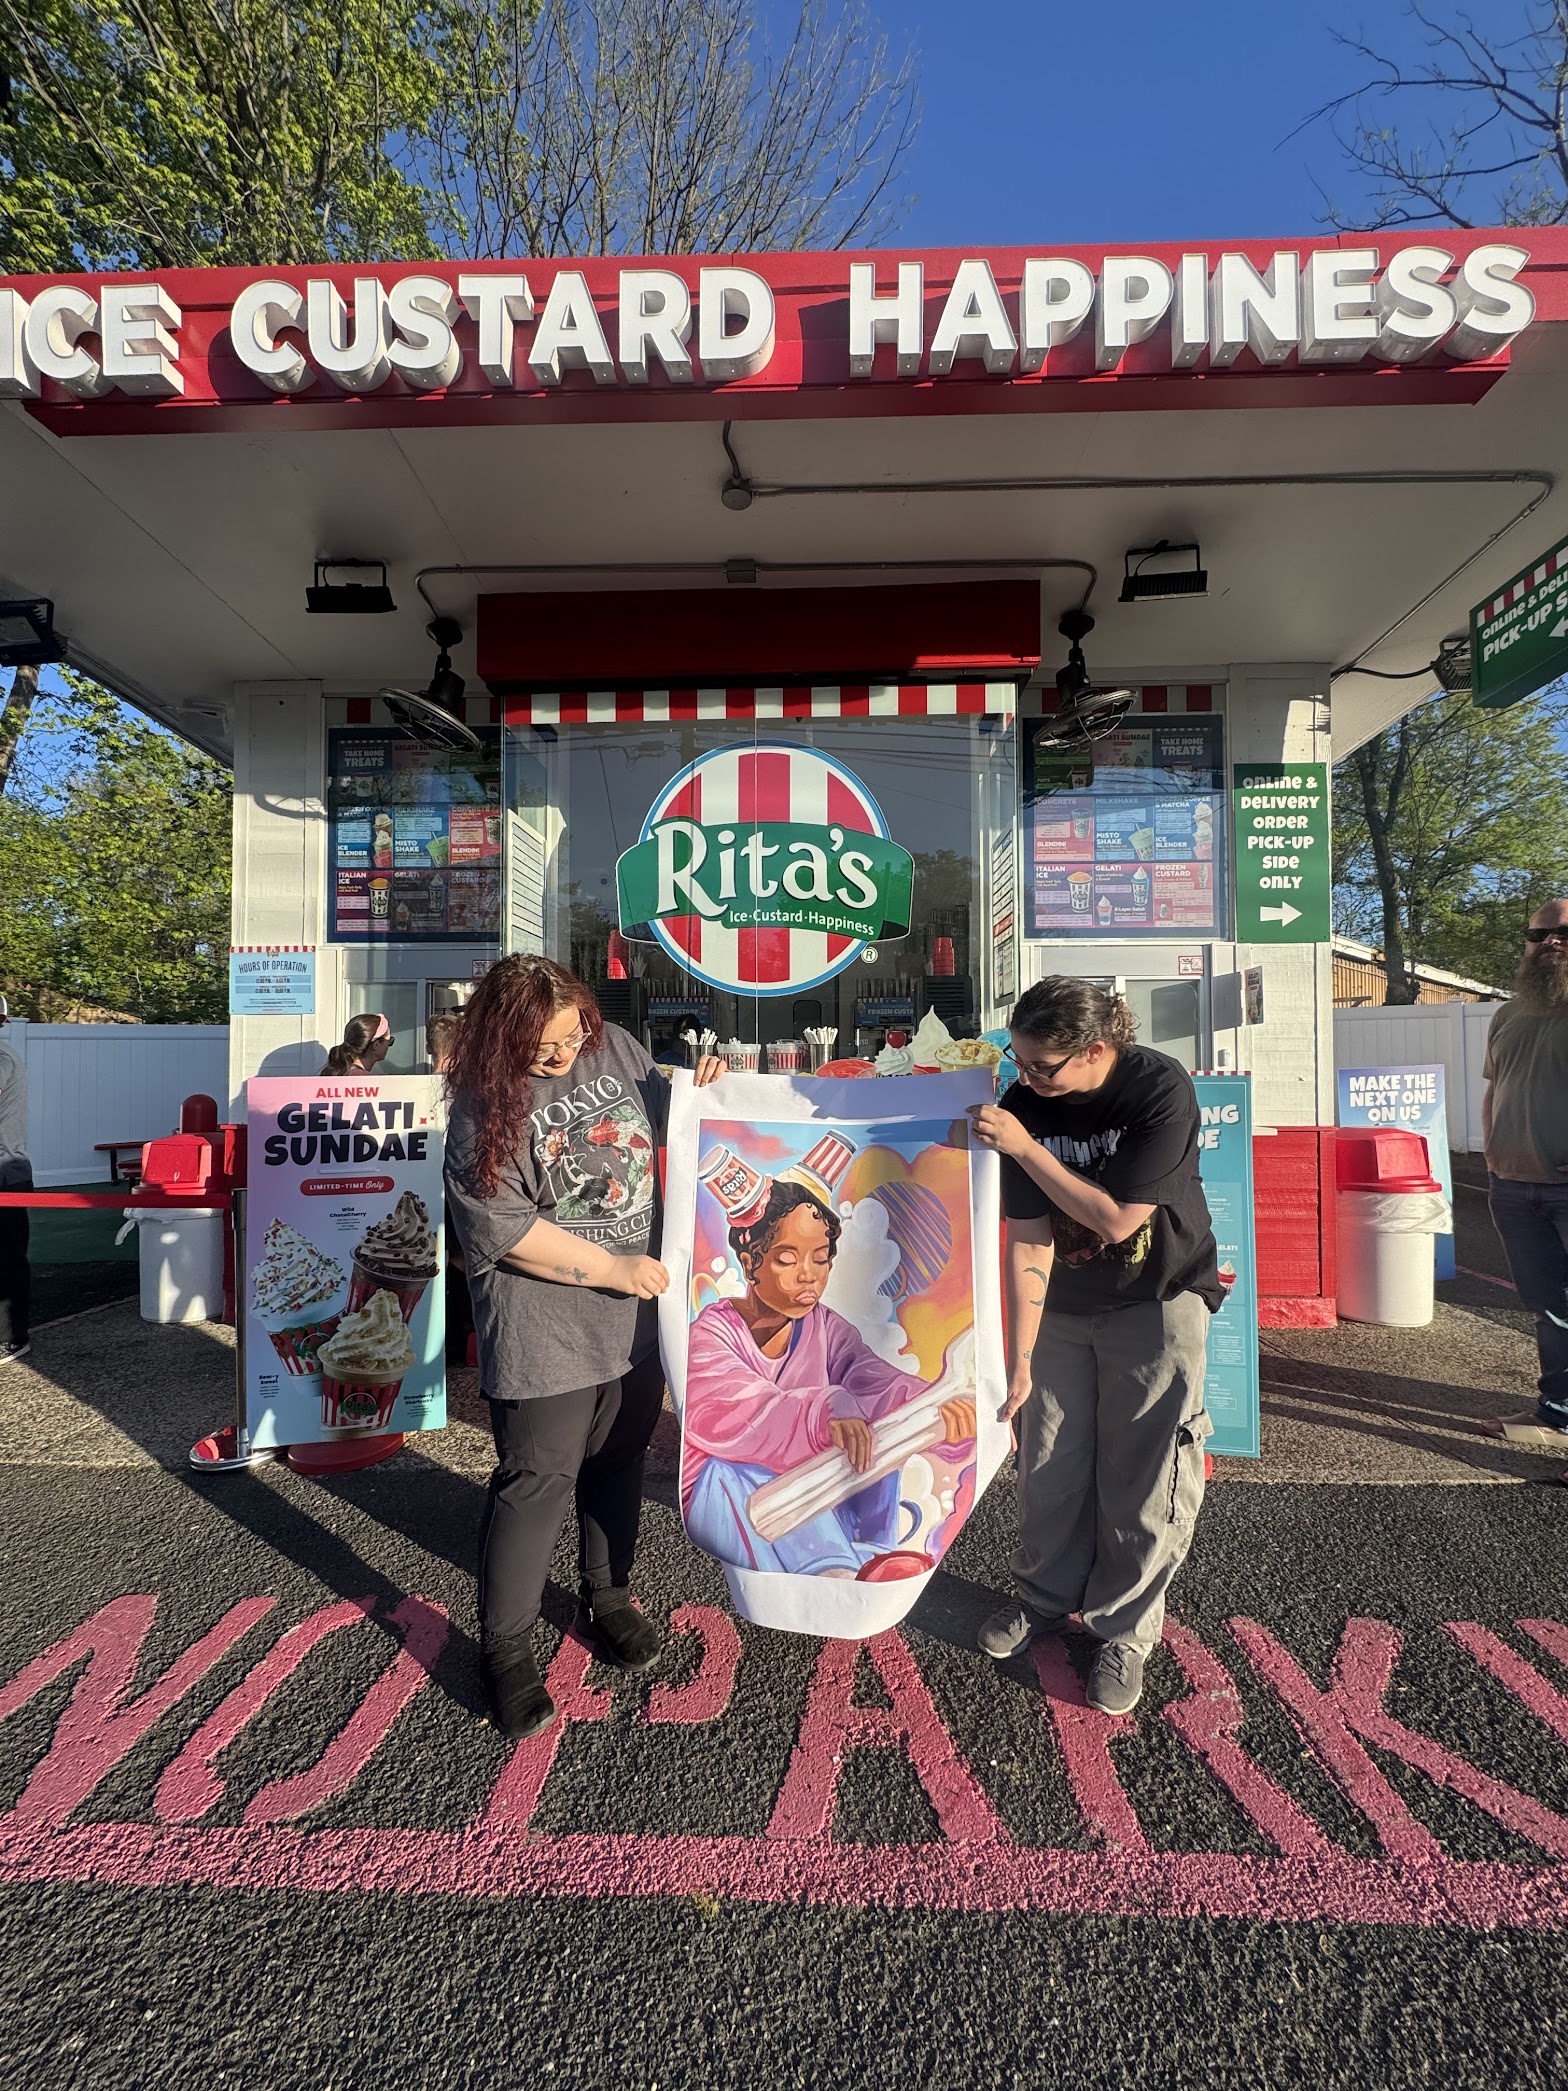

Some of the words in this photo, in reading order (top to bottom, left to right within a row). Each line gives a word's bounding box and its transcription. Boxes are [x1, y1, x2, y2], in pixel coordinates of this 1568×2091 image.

[0, 283, 184, 398] ICE
[229, 266, 776, 394] CUSTARD
[849, 244, 1536, 377] HAPPINESS
[1527, 594, 1538, 609] &
[1483, 602, 1553, 663] PICK-UP
[364, 749, 384, 757] HOME
[1161, 746, 1204, 756] TREATS
[344, 757, 384, 767] TREATS
[1306, 776, 1318, 789] &
[1248, 836, 1314, 849] PICK-UP
[654, 821, 879, 918] Rita's
[239, 961, 261, 974] HOURS
[262, 960, 270, 971] OF
[272, 960, 308, 973] OPERATION
[1350, 1075, 1401, 1092] MAKE
[1403, 1073, 1436, 1090] THE
[316, 1087, 341, 1099] ALL
[344, 1086, 380, 1098] NEW
[1350, 1090, 1399, 1107] NEXT
[1402, 1088, 1436, 1105] ONE
[530, 1074, 622, 1140] TOKYO
[1367, 1107, 1396, 1122] ON
[1399, 1105, 1422, 1121] US
[277, 1101, 415, 1134] GELATI
[264, 1131, 428, 1166] SUNDAE
[309, 1181, 364, 1191] LIMITED-TIME
[365, 1180, 385, 1191] Only
[631, 1213, 651, 1231] CL
[0, 1593, 450, 1826] NO
